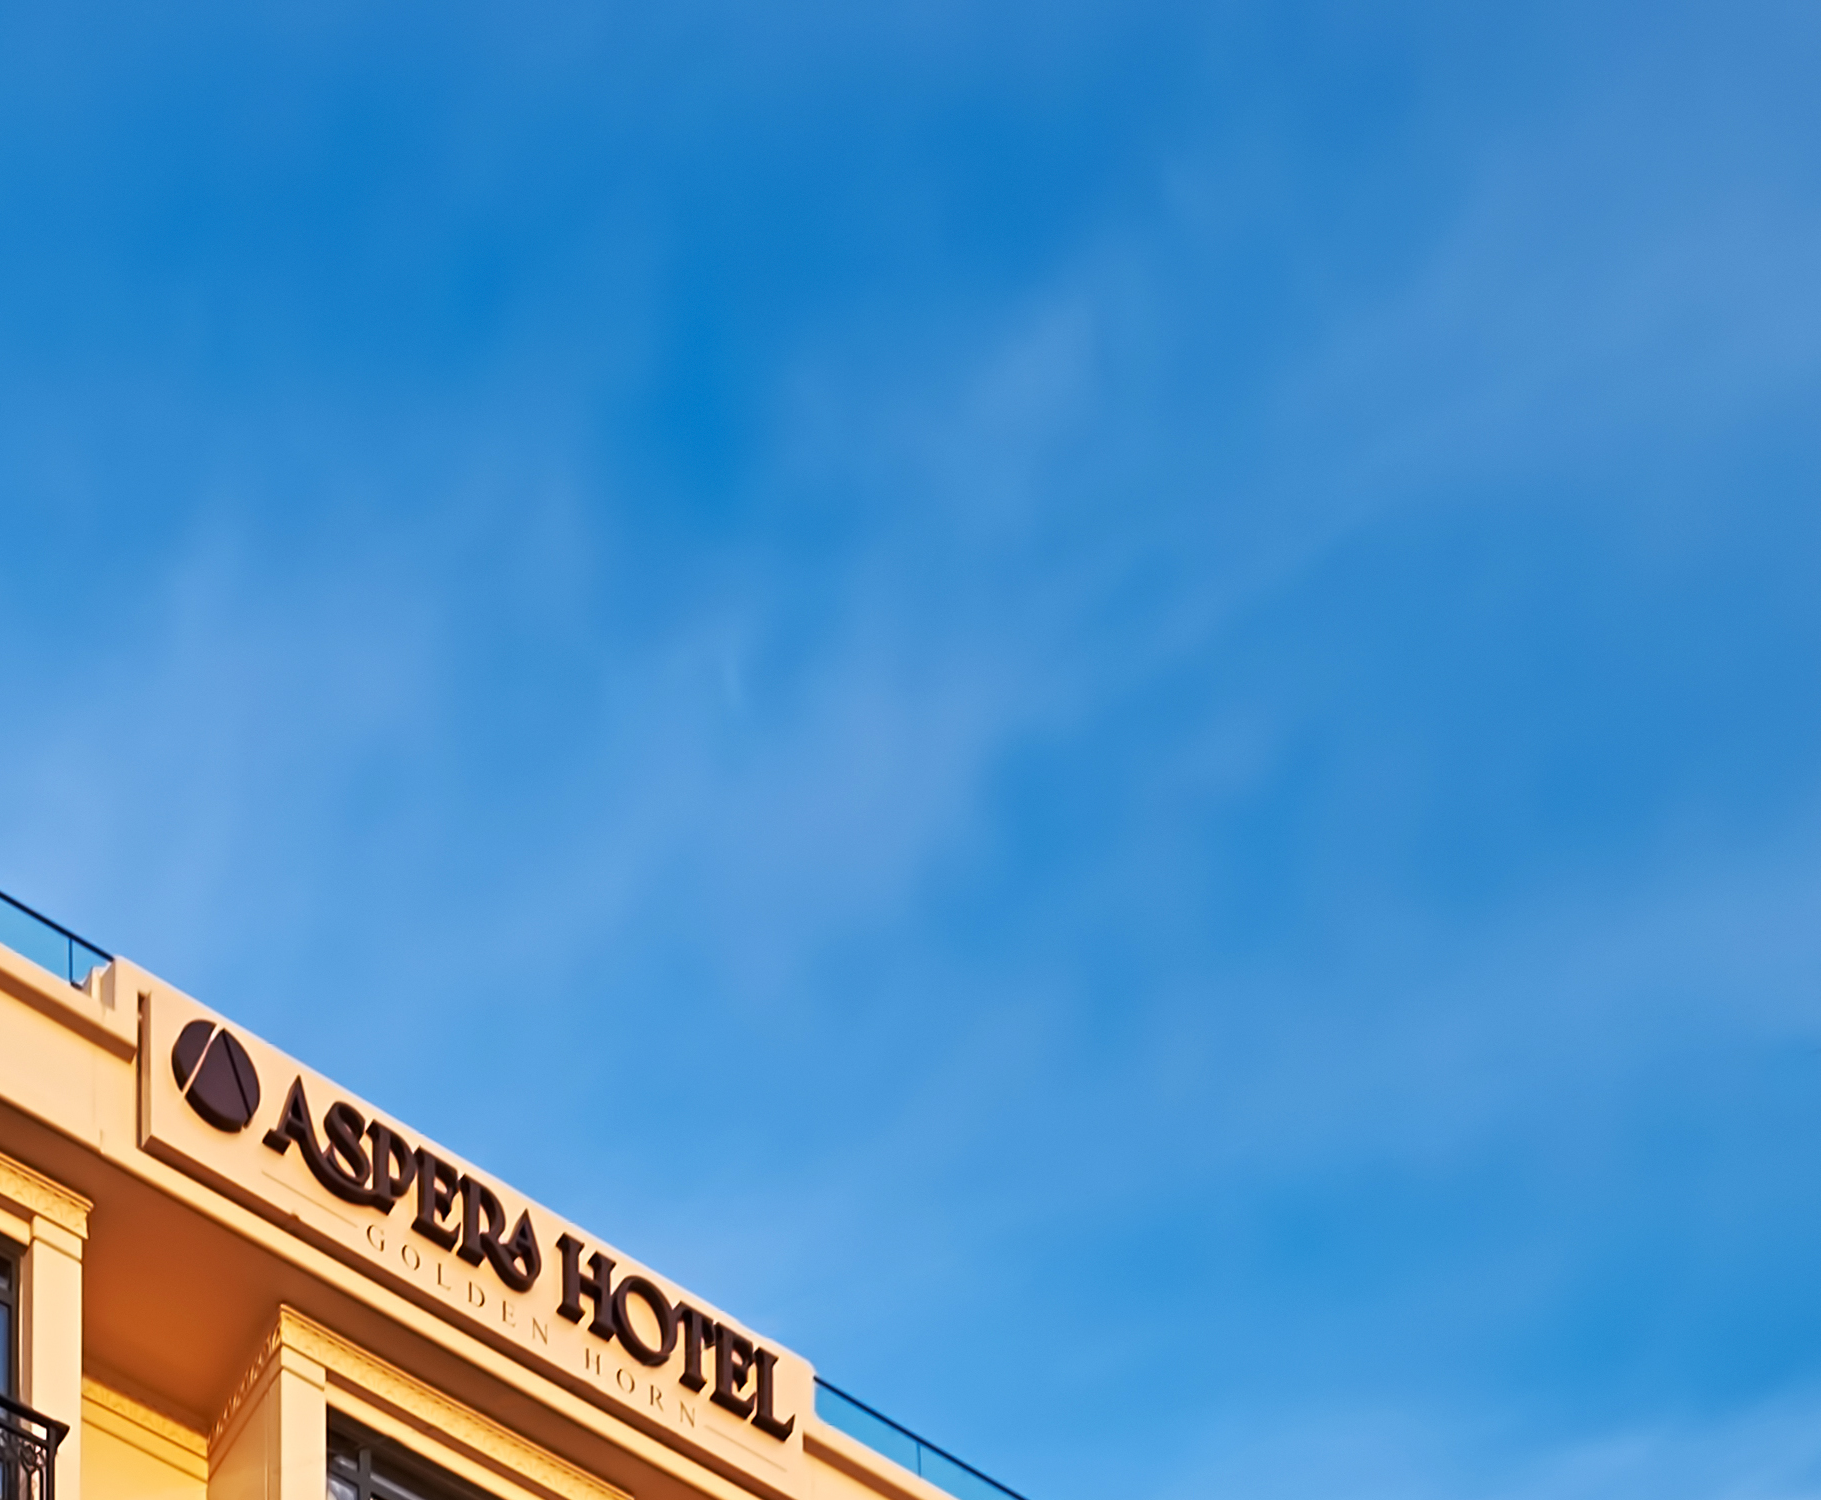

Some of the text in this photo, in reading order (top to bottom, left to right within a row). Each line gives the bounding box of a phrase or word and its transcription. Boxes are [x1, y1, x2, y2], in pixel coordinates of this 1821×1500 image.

[263, 1076, 796, 1441] ASPERA HOTEL
[366, 1223, 697, 1429] GOLDEN HORN
